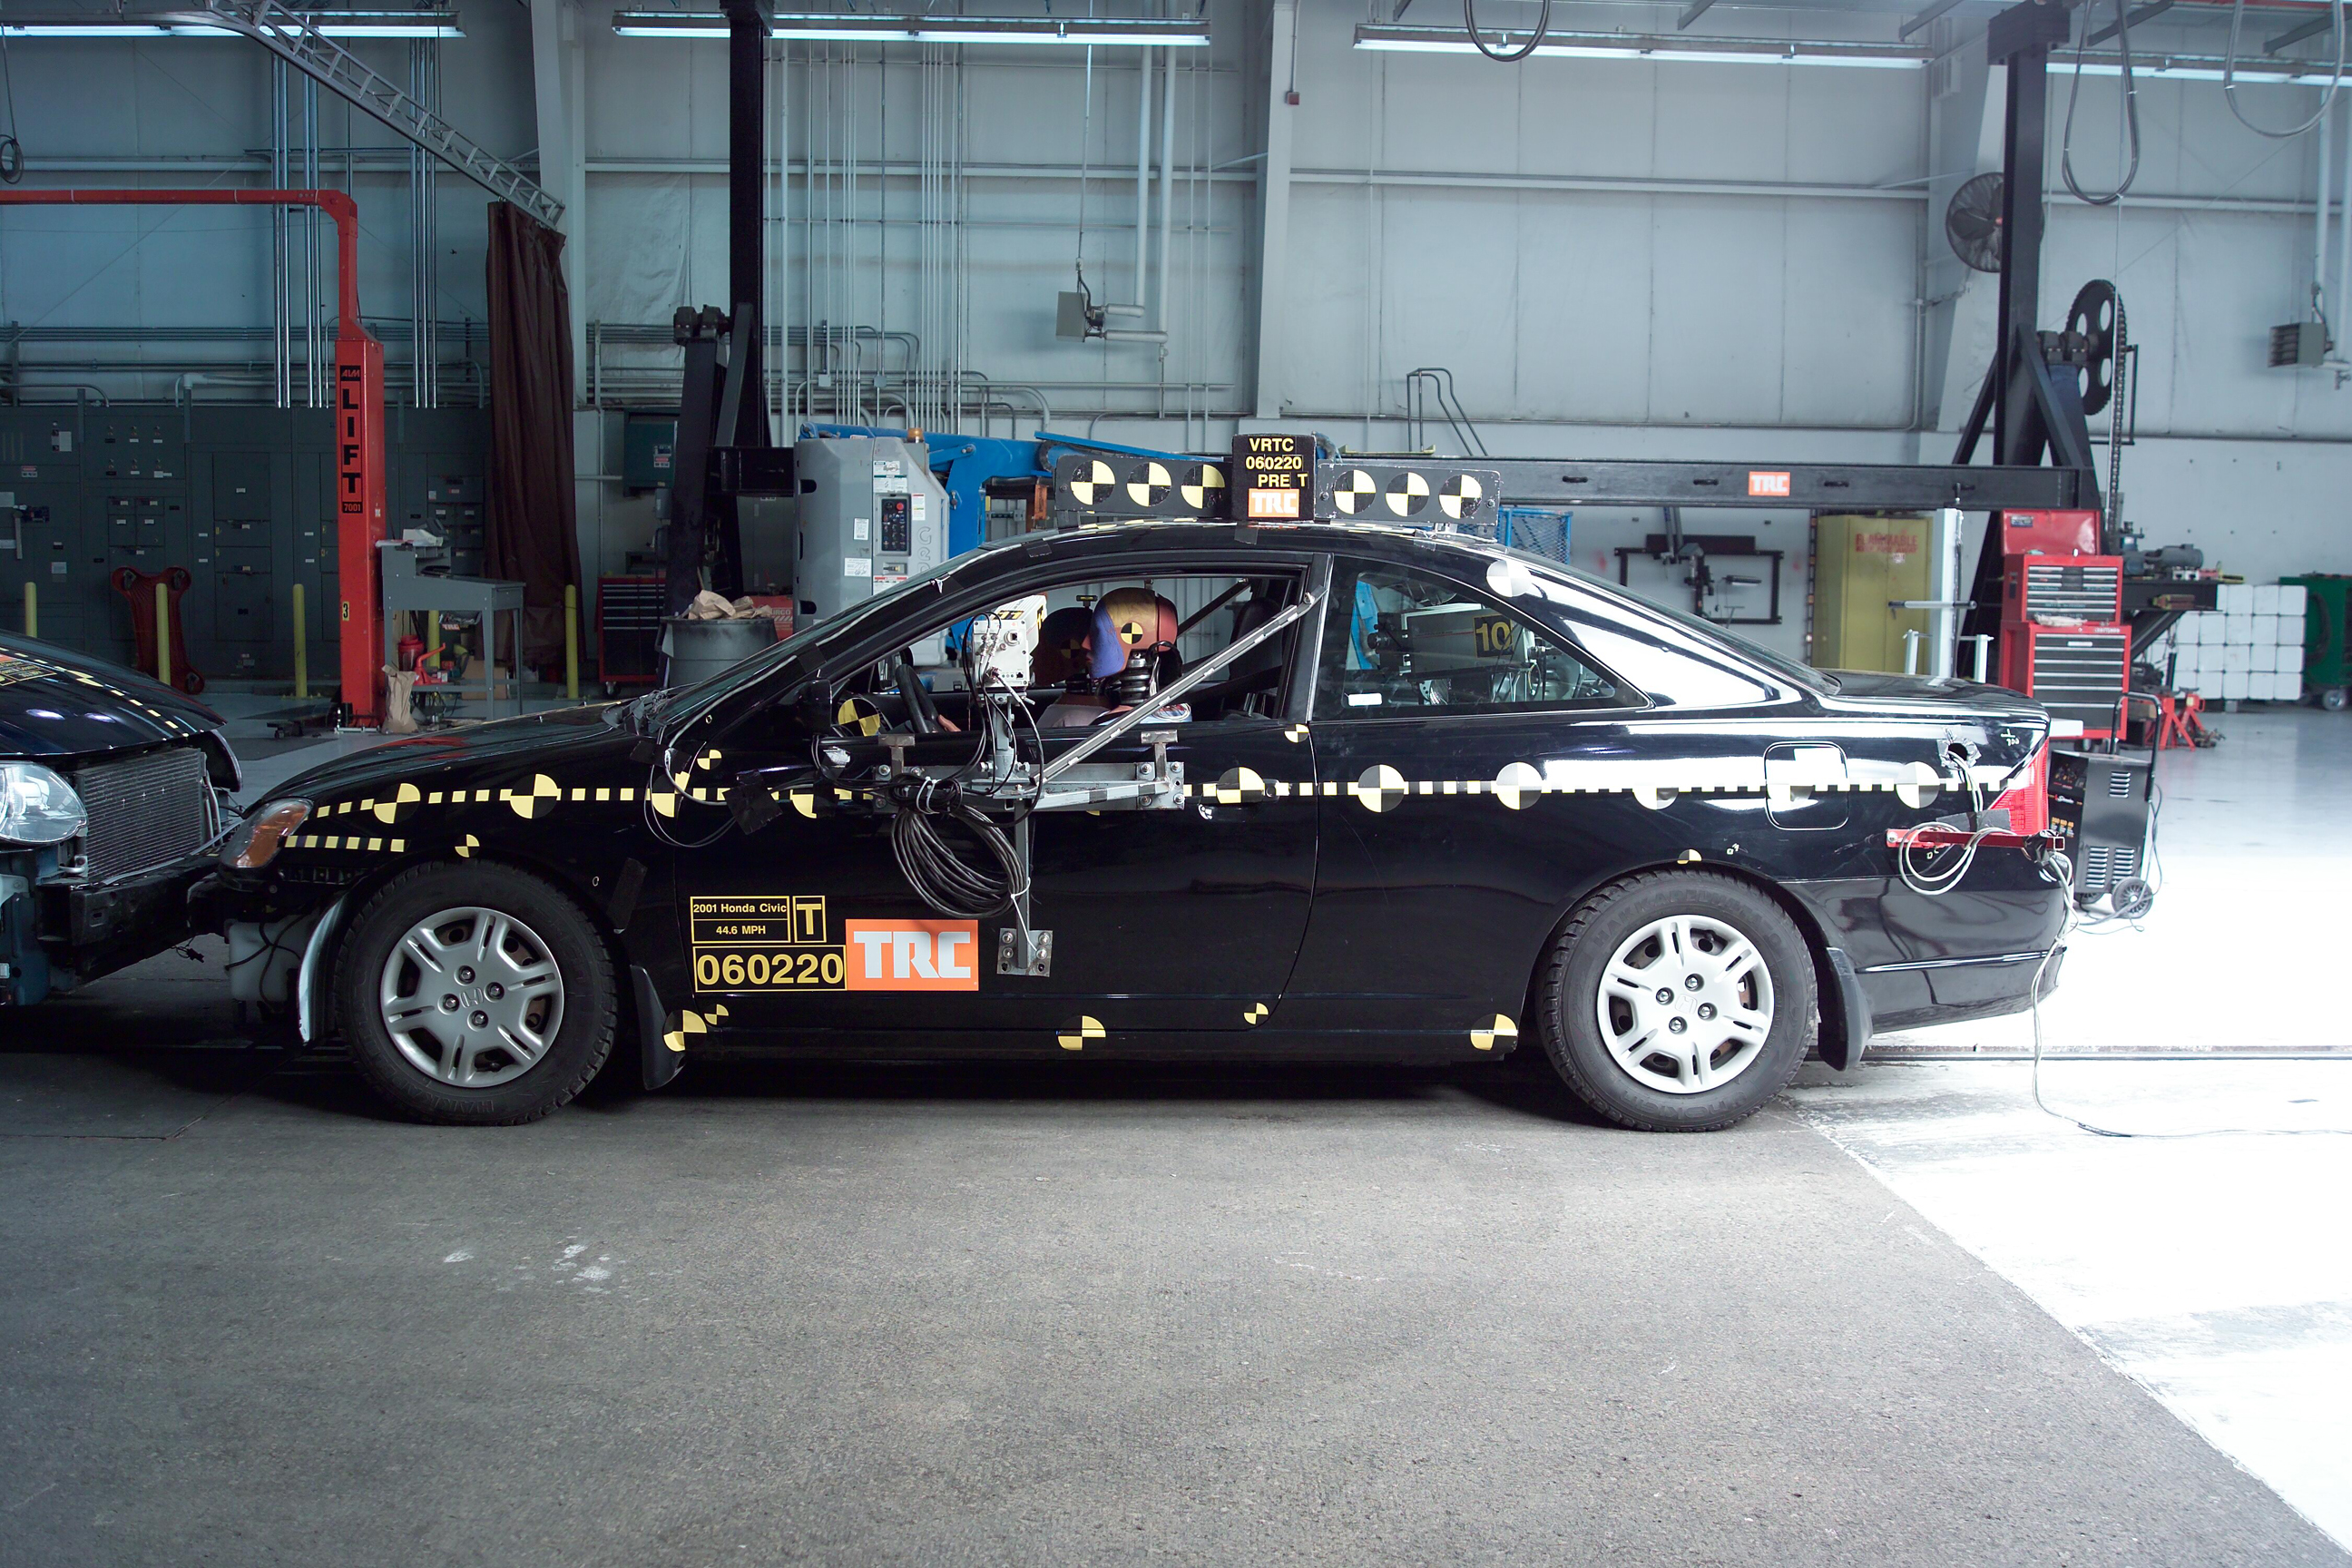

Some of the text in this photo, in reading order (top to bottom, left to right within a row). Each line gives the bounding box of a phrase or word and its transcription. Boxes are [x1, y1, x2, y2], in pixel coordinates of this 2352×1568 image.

[342, 388, 360, 494] LIFT
[1250, 437, 1294, 452] VRTC
[1245, 456, 1302, 470] 060220
[1258, 473, 1308, 487] PRE T
[1751, 475, 1788, 493] TRC
[344, 503, 361, 512] 7001
[1251, 492, 1297, 514] TRC
[343, 603, 348, 619] 3
[1475, 622, 1511, 652] 10
[693, 903, 821, 935] 2001 Honda Civic T
[716, 926, 766, 935] 44.6 MPH
[853, 931, 971, 979] TRC
[697, 954, 844, 985] 060220
